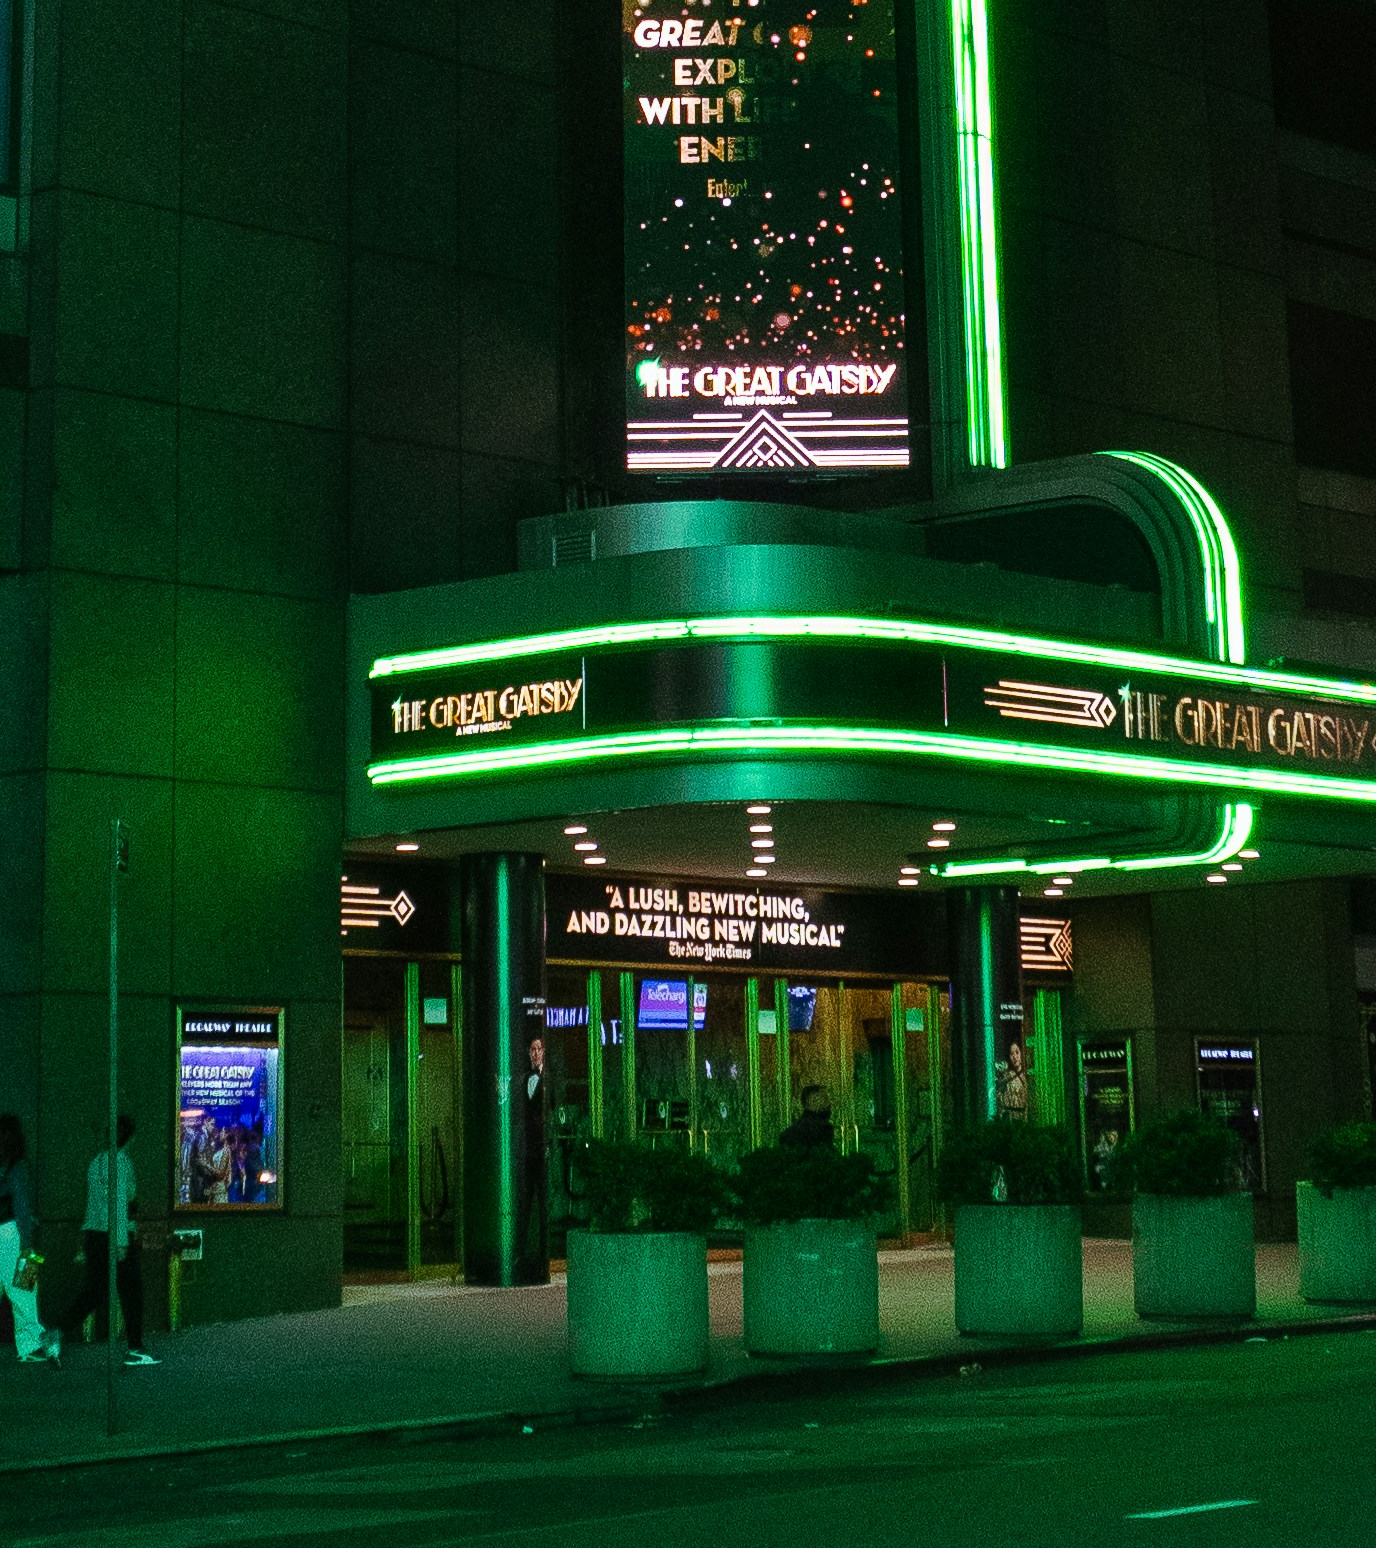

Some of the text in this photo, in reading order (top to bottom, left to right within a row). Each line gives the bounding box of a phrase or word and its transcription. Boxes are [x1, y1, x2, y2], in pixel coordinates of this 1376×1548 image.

[634, 19, 746, 48] GREAT
[638, 96, 724, 125] WITH
[640, 363, 897, 397] THE GREAT GATSBY
[392, 677, 583, 734] THE GREAT GATSBY
[1118, 683, 1369, 761] THE GREAT GATSBY
[605, 885, 810, 923] “A LUSH, BEWITCHING,
[566, 911, 610, 935] AND
[614, 913, 710, 940] DAZZLING
[714, 917, 757, 943] NEW
[669, 941, 752, 962] The New York Times
